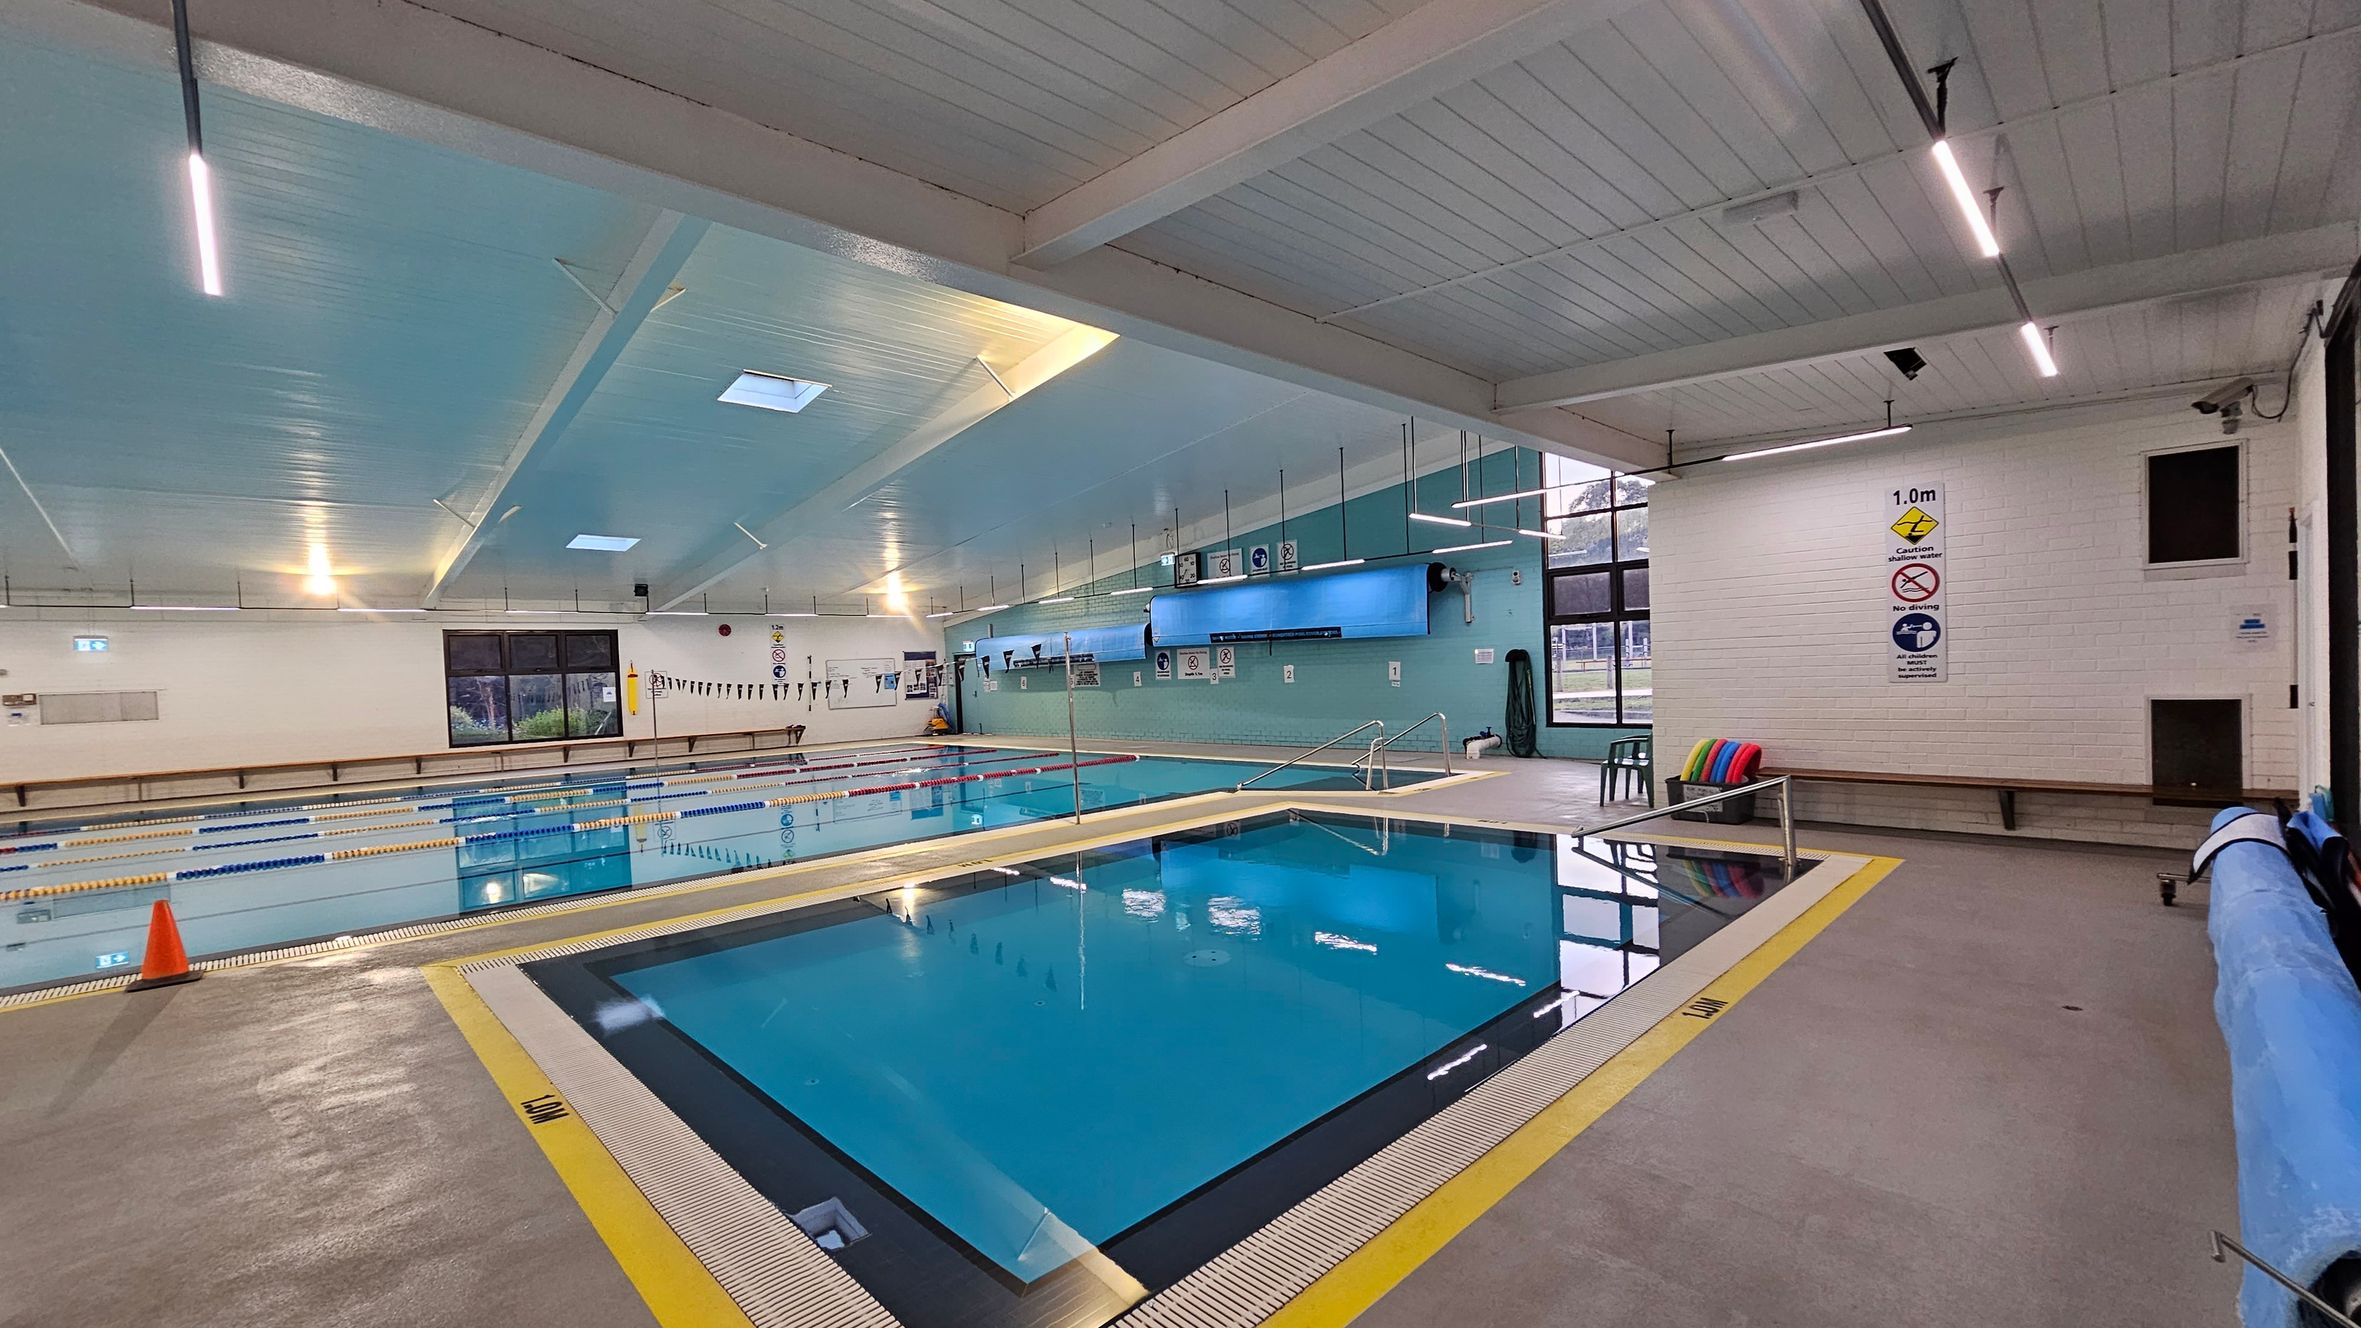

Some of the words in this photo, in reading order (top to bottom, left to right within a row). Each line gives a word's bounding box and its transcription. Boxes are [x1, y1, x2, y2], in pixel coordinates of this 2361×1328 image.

[1893, 487, 1936, 506] 1.0m
[1896, 546, 1934, 554] Caution
[1888, 554, 1918, 562] shallow
[1920, 552, 1943, 560] water
[1286, 670, 1292, 679] 2
[1392, 666, 1397, 676] 1
[1211, 672, 1217, 681] 3
